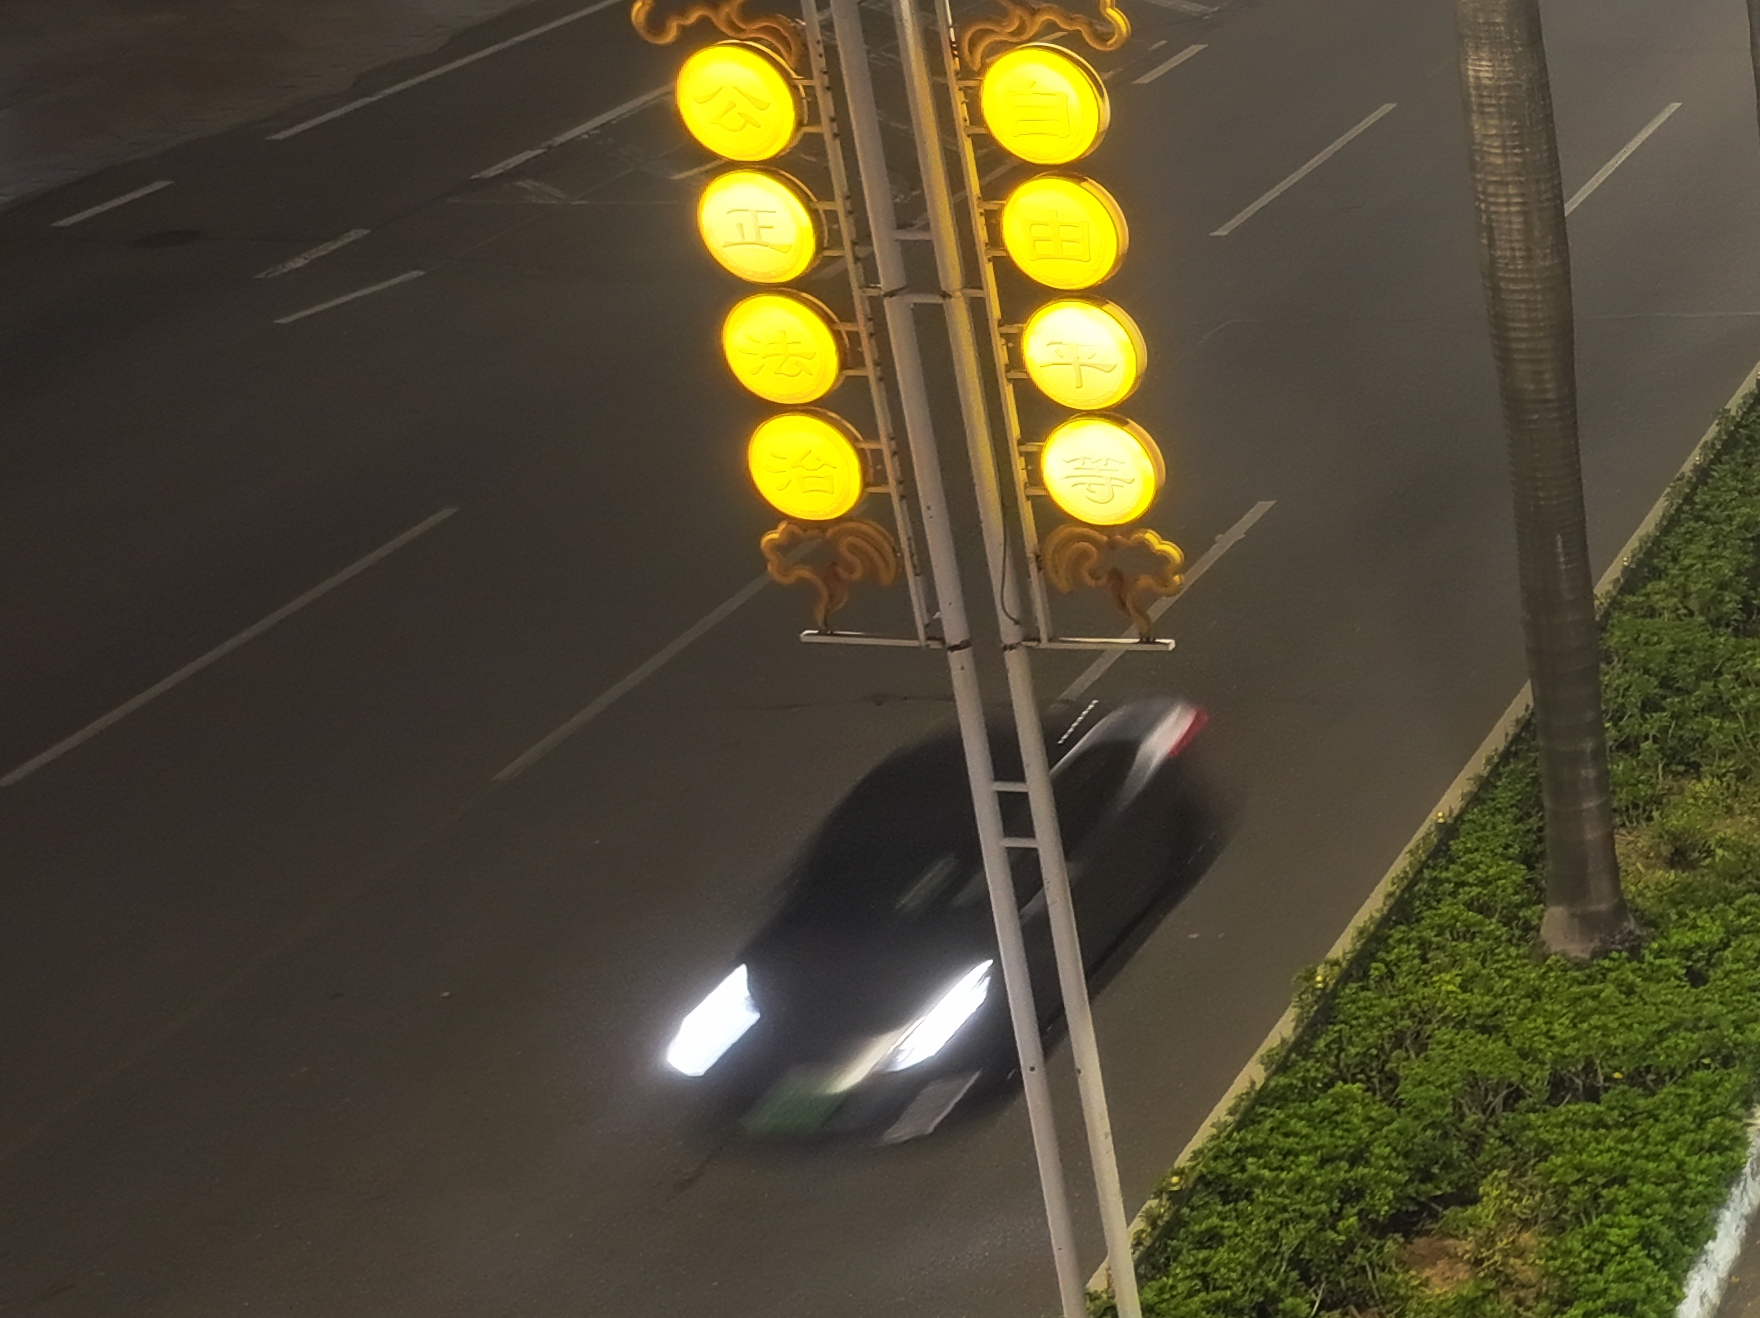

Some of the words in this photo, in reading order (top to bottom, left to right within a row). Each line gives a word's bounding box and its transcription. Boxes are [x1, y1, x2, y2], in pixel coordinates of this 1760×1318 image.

[695, 83, 838, 496] 公正法治
[1011, 79, 1136, 504] 自由平等
